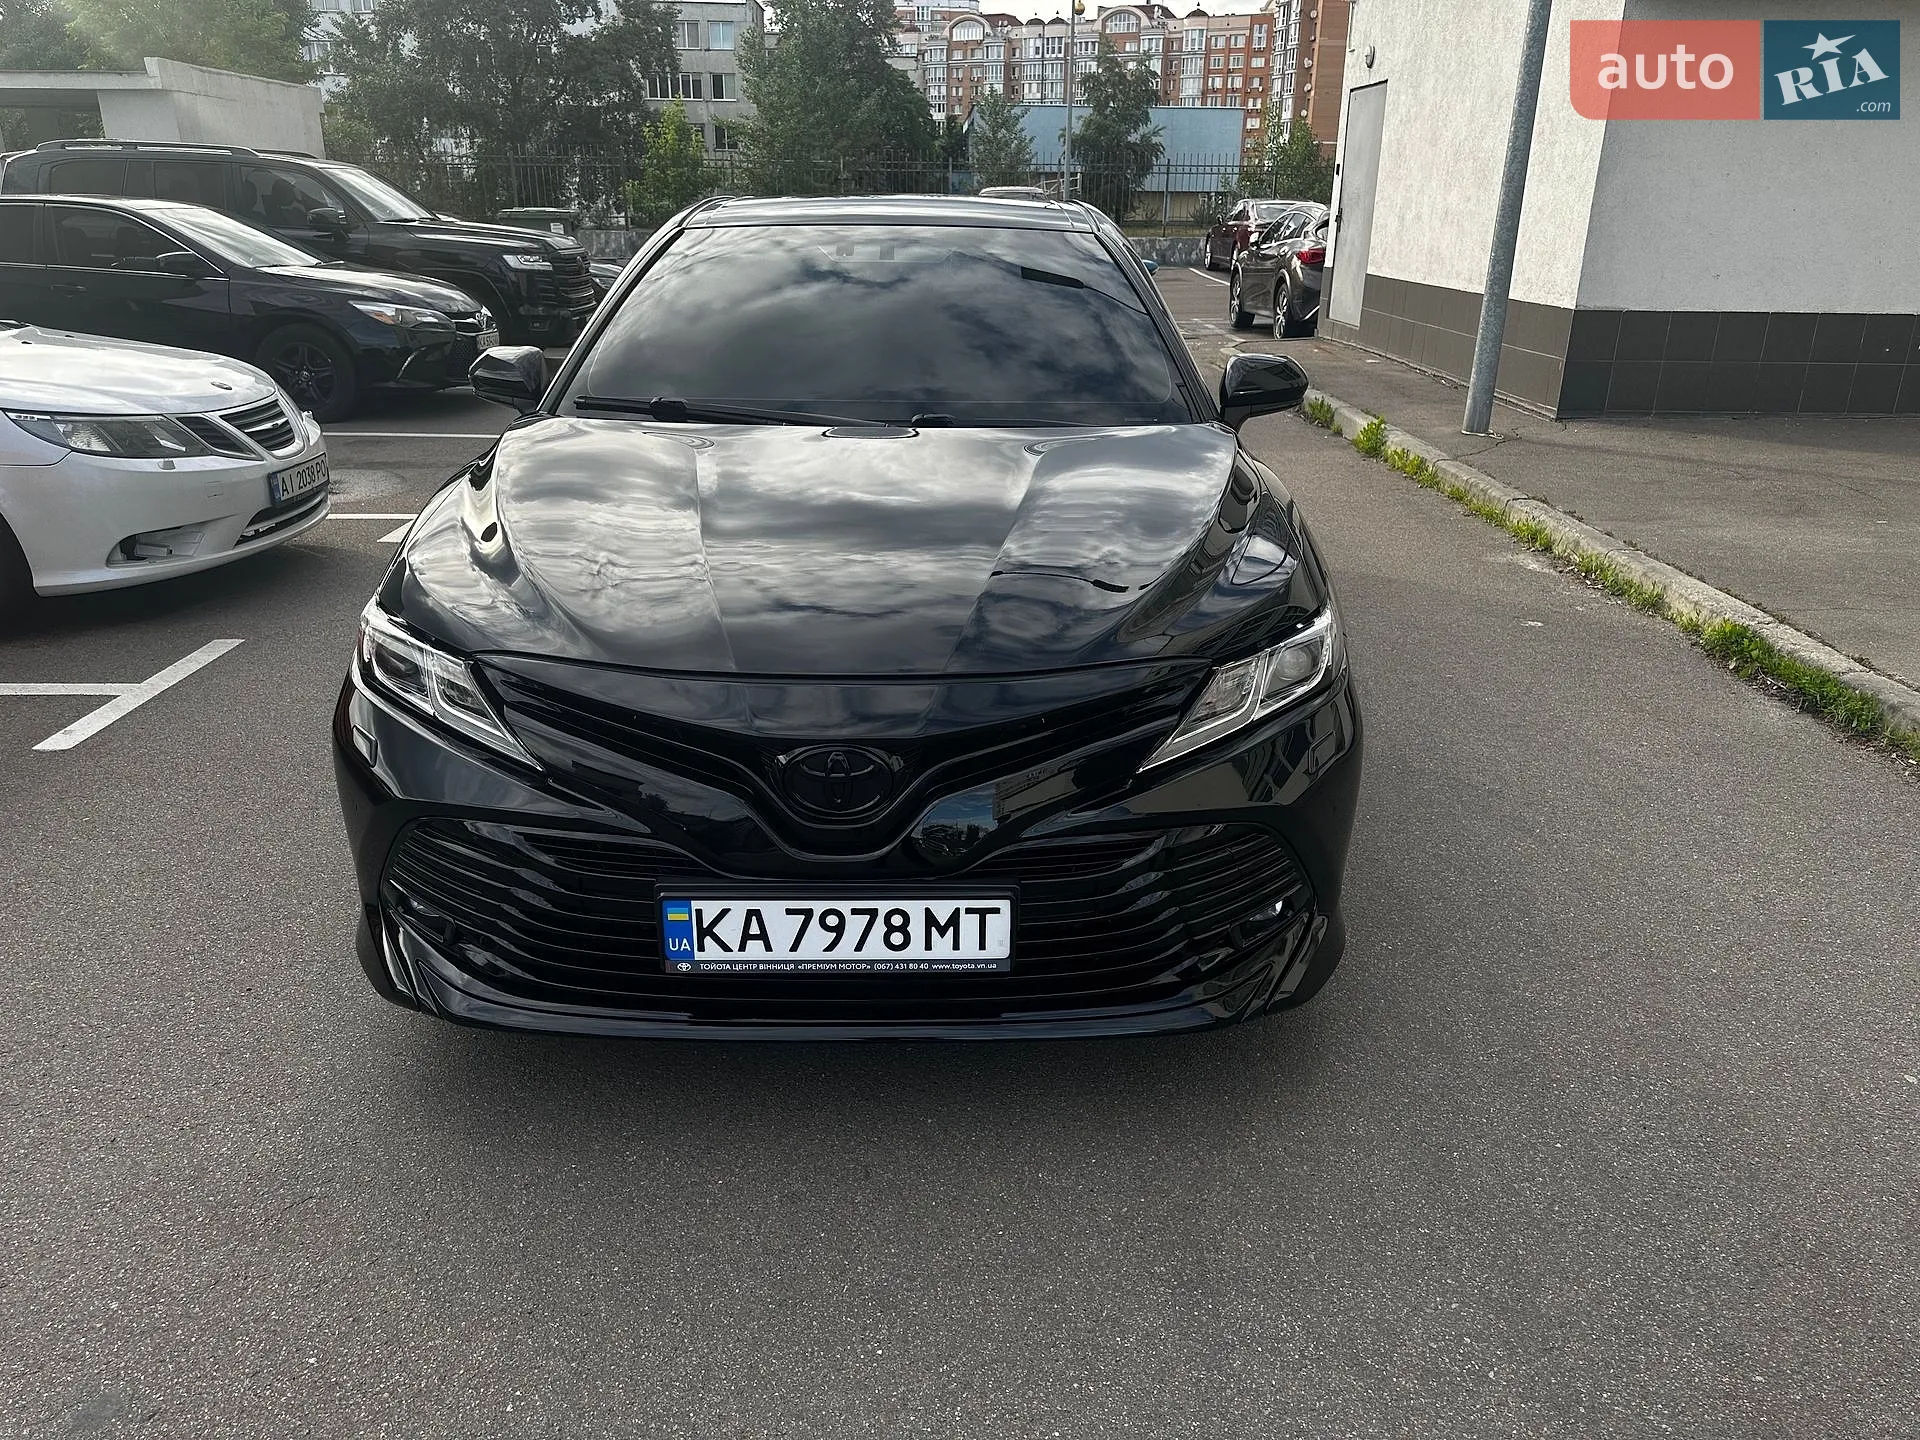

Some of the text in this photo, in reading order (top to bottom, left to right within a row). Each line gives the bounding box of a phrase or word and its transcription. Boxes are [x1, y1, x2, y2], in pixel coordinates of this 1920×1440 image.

[296, 465, 316, 490] 2038
[695, 907, 1001, 953] KA 7978 MT
[669, 937, 691, 951] UA
[700, 962, 731, 971] ТОЙОТА
[732, 963, 757, 971] ЦЕНТР
[759, 963, 795, 971] ВІННИЦЯ
[873, 962, 894, 971] (067)
[894, 962, 907, 970] 431
[908, 962, 918, 970] 80
[919, 962, 929, 970] 40
[931, 962, 997, 971] www.toyota.vn.ua
